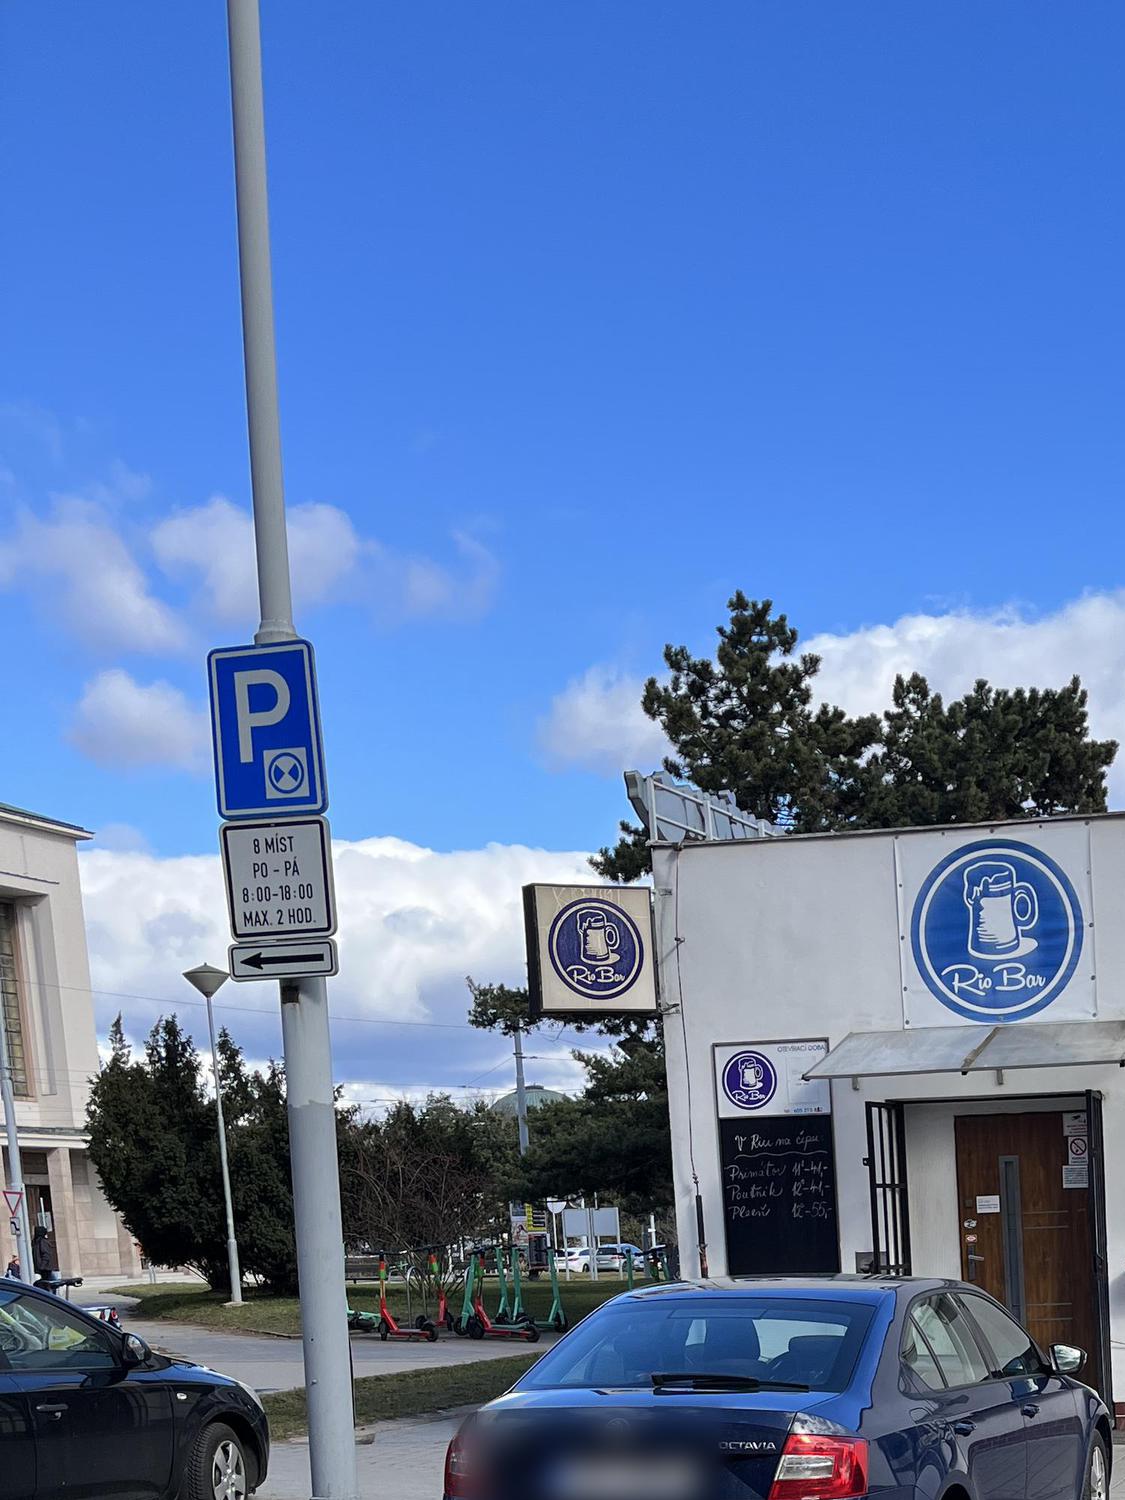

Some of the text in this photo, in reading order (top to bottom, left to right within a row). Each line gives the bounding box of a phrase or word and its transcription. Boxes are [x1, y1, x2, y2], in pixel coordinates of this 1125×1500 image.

[233, 668, 291, 764] P
[253, 832, 295, 855] 8 MÍST
[253, 862, 269, 879] PO
[284, 856, 300, 877] PÁ
[242, 883, 314, 904] 8:00-18:00
[243, 907, 317, 927] MAX. 2 HOD.
[566, 965, 625, 985] Rio Bar
[940, 962, 1046, 996] Rio Bar
[719, 1441, 777, 1451] OCTAVIA
